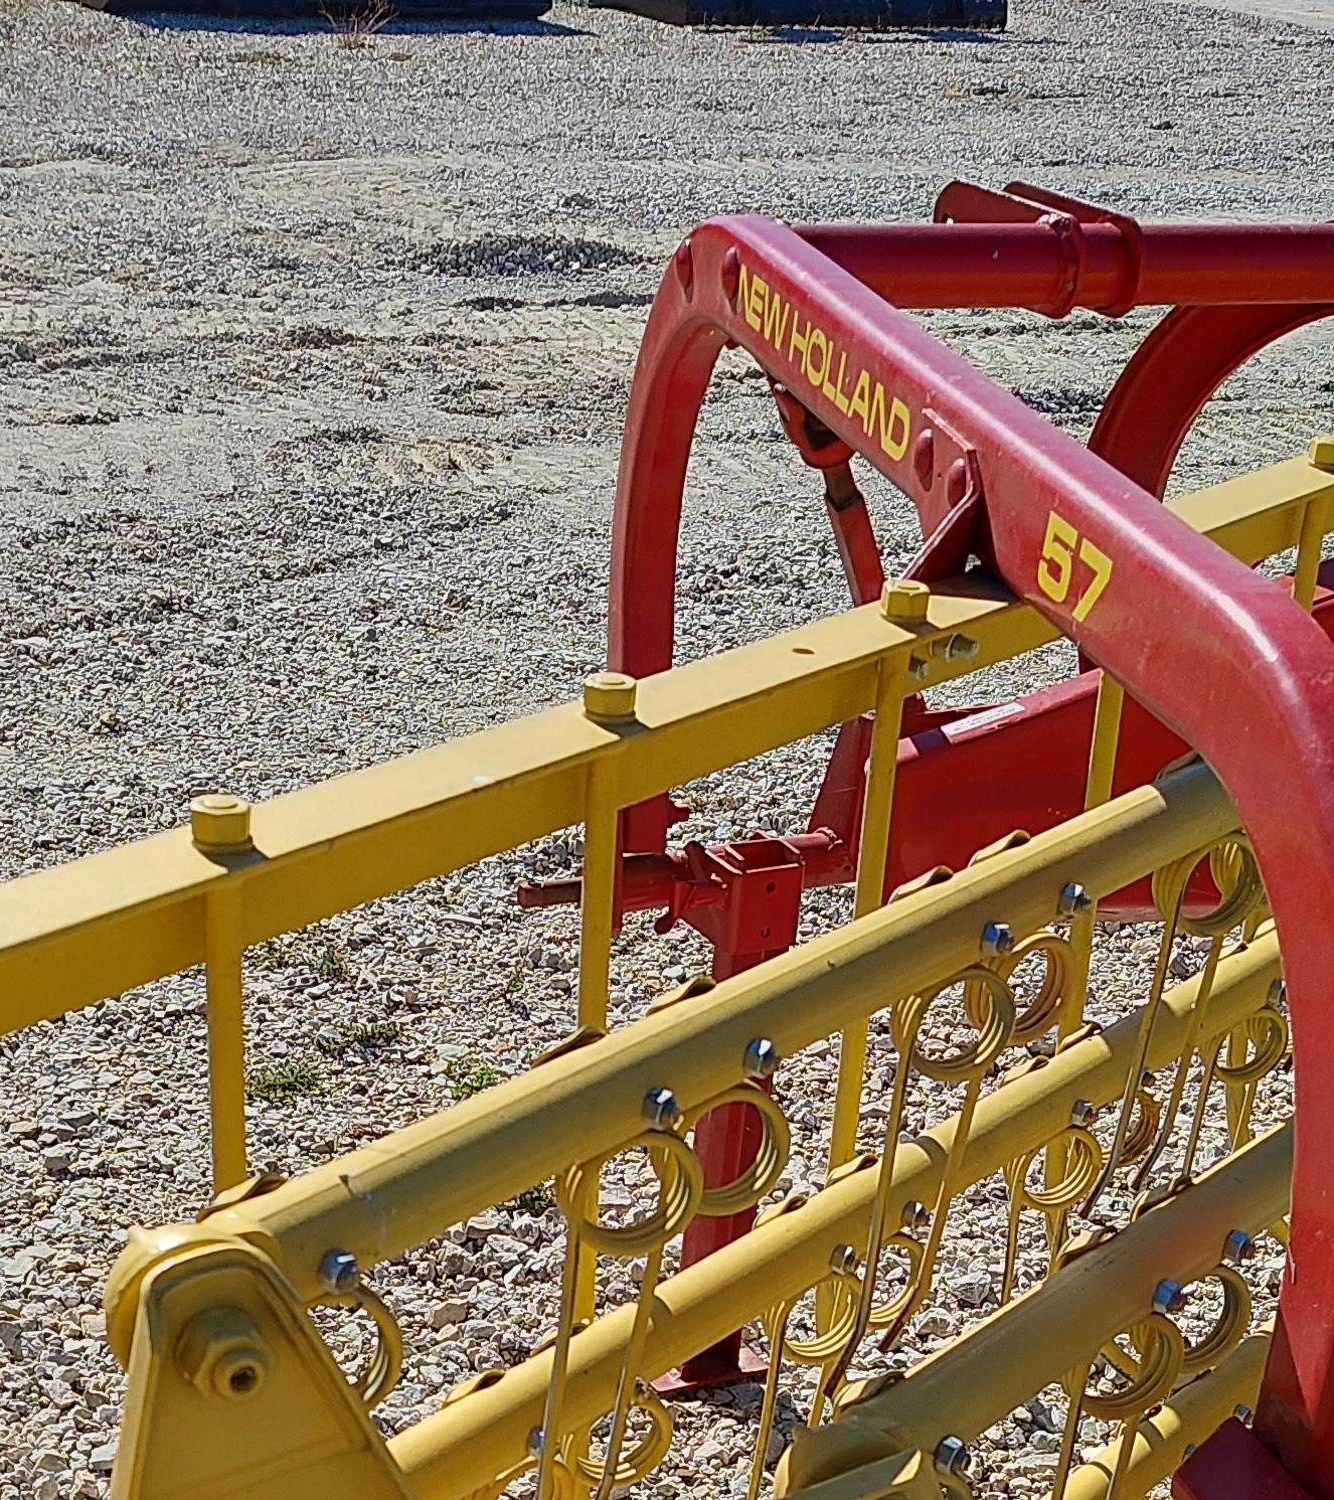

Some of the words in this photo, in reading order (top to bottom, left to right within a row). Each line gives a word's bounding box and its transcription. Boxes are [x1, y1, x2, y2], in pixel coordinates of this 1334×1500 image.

[736, 263, 791, 350] NEW
[788, 310, 911, 461] HOLLAND
[1037, 510, 1113, 623] 57
